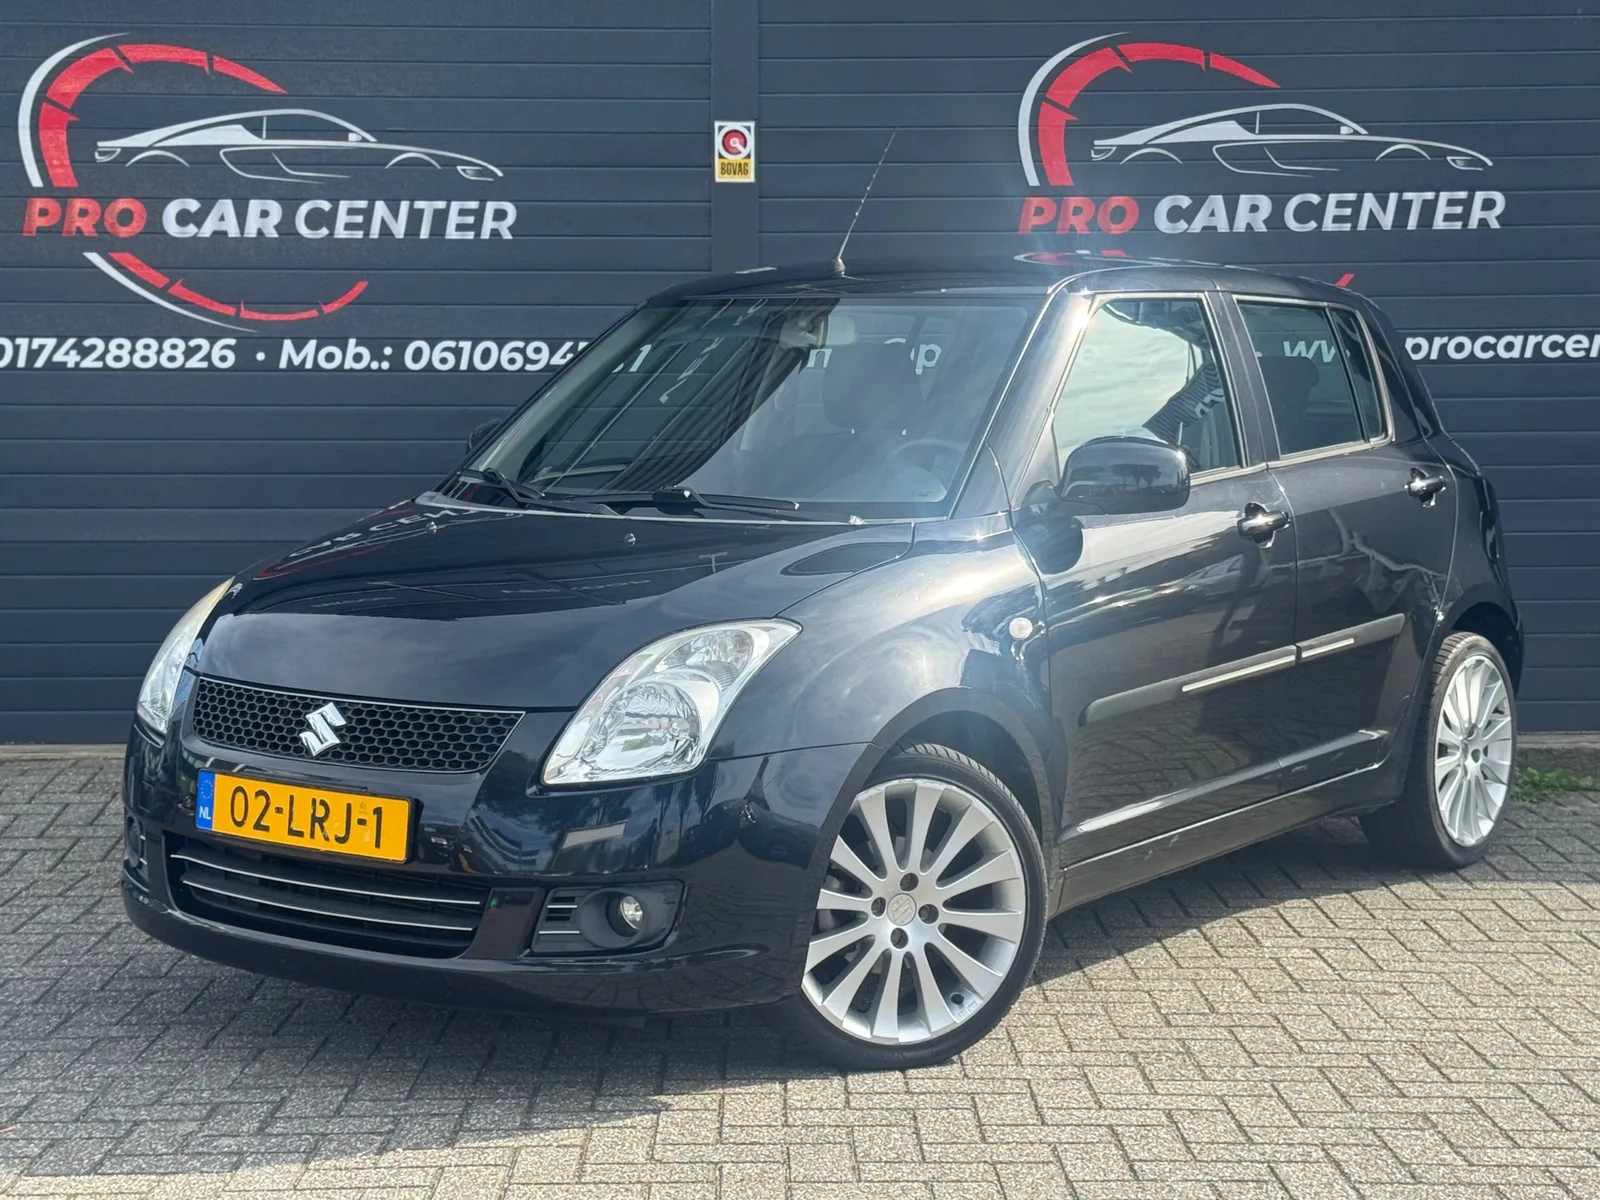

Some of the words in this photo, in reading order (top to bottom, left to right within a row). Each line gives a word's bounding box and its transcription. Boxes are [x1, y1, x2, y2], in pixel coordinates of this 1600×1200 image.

[720, 162, 749, 176] BOVAG
[22, 198, 147, 238] PRO
[162, 198, 283, 238] CAR
[295, 199, 518, 240] CENTER
[1018, 196, 1139, 235] PRO
[1154, 194, 1272, 234] CAR
[1284, 191, 1506, 233] CENTER
[279, 338, 393, 370] Mob.:
[199, 805, 212, 821] NL
[230, 785, 383, 849] 02-LRJ-1
